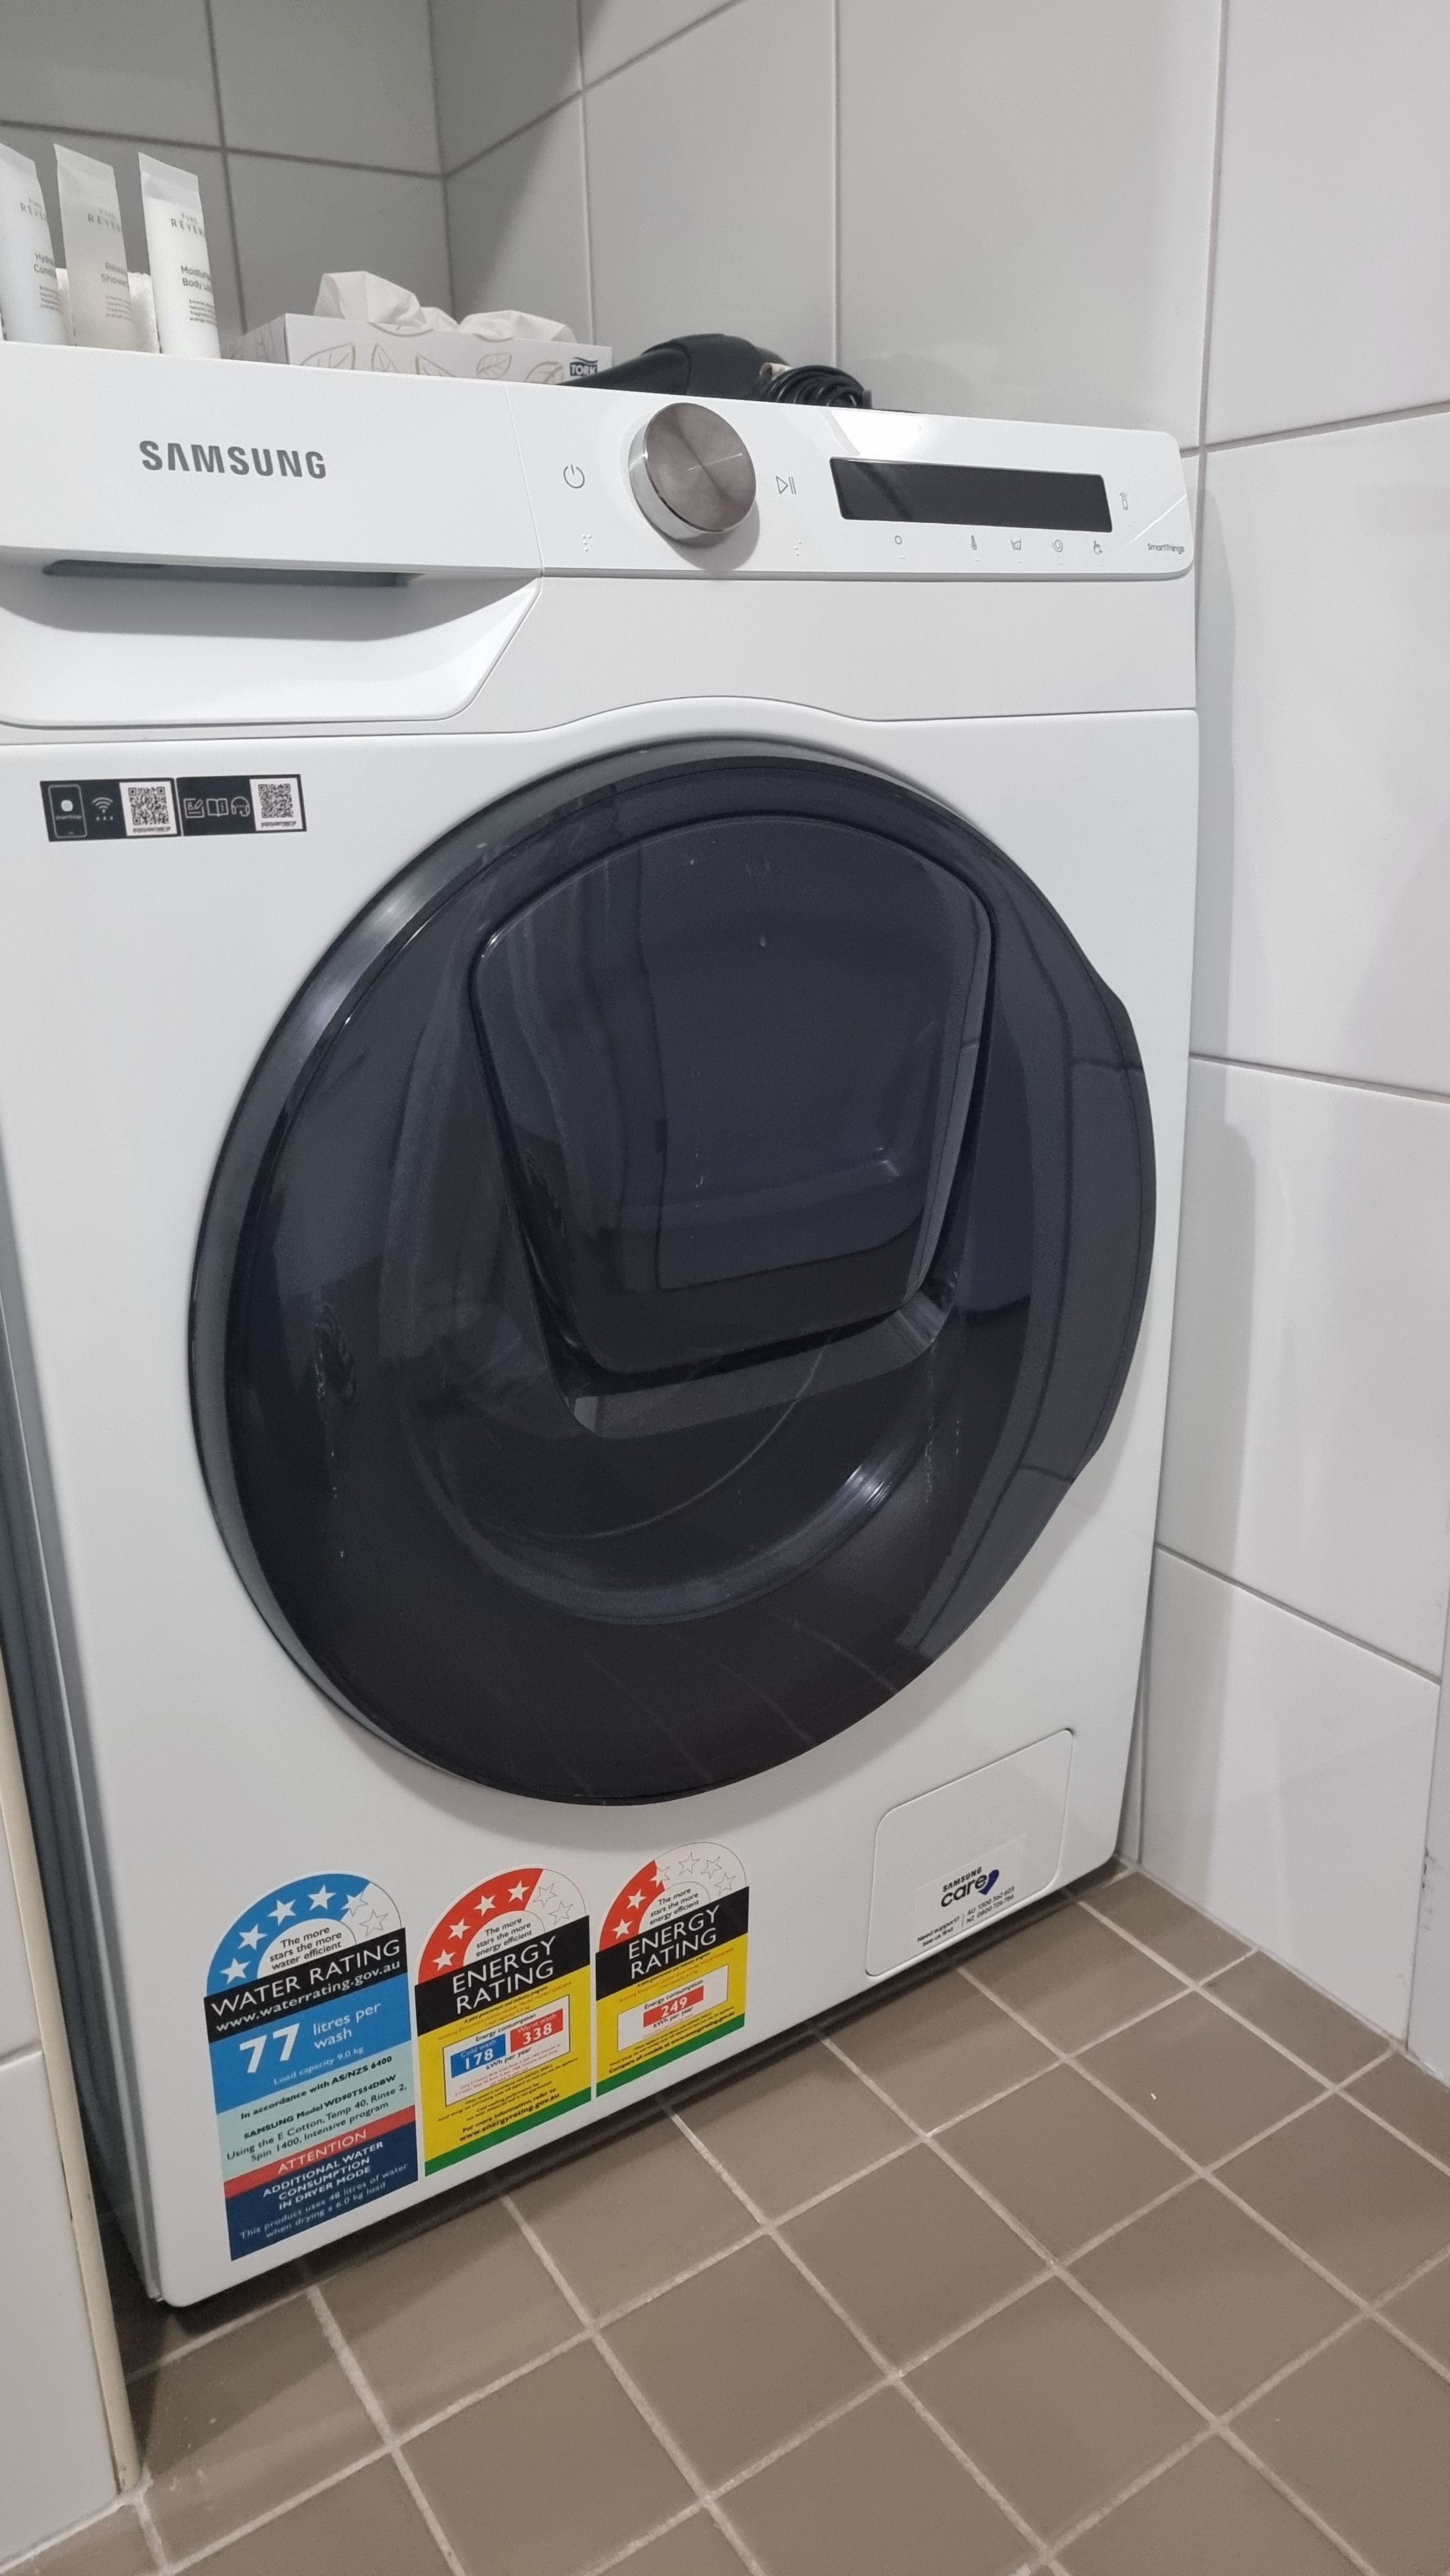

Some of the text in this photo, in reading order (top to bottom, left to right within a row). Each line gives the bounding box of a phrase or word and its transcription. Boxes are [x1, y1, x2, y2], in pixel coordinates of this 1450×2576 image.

[182, 278, 202, 290] Body
[571, 364, 596, 376] TORK
[139, 440, 326, 479] SAMSUNG
[941, 1874, 987, 1907] care
[943, 1866, 982, 1892] SAMSUNG
[649, 1899, 700, 1926] energy efficient
[650, 1892, 699, 1917] stars the more
[658, 1888, 691, 1906] The more
[280, 1927, 330, 1948] The more
[476, 1922, 531, 1948] stars the more
[484, 1918, 522, 1936] The more
[628, 1904, 720, 1960] ENERGY
[917, 1930, 934, 1942] Need
[270, 1932, 341, 1962] stars the more
[272, 1941, 341, 1970] water efficient
[476, 1930, 533, 1957] energy efficient
[631, 1927, 716, 1979] RATING
[211, 1939, 400, 2017] WATER RATING
[452, 1935, 556, 1994] ENERGY
[216, 1961, 400, 2032] www.waterrating.gov.au
[455, 1960, 554, 2015] RATING
[644, 1998, 665, 2010] Energy
[665, 1979, 704, 2000] consumption
[313, 2003, 381, 2035] litres per
[516, 2021, 538, 2033] Warm
[539, 2013, 557, 2023] wash
[661, 1996, 687, 2018] 249
[314, 2027, 351, 2049] wash
[476, 2029, 496, 2042] Energy
[498, 2013, 536, 2033] consumption
[522, 2023, 553, 2045] 338
[239, 2023, 300, 2074] 77
[460, 2039, 497, 2058] Cold wash
[465, 2048, 494, 2070] 178
[486, 2047, 532, 2071] kWh per year
[274, 2046, 364, 2085] Load capacity 9.0 kg
[254, 2090, 307, 2115] accordance
[309, 2081, 329, 2094] with
[331, 2065, 368, 2084] AS/NZS
[371, 2055, 392, 2069] 6400
[227, 2145, 256, 2160] Using
[258, 2138, 274, 2148] the
[278, 2131, 284, 2140] E
[287, 2116, 325, 2135] Cotton,
[326, 2106, 351, 2121] Temp
[355, 2100, 369, 2109] 40,
[371, 2090, 396, 2103] Rinse
[244, 2115, 294, 2139] SAMSUNG
[296, 2104, 323, 2119] Model
[459, 2093, 560, 2141] www.energyrating.gov.au
[463, 2125, 473, 2133] For
[475, 2116, 493, 2128] more
[494, 2099, 533, 2118] information,
[533, 2092, 549, 2101] refer
[251, 2102, 388, 2161] Spin 1400, Intensive program
[277, 2129, 367, 2174] ATTENTION
[263, 2141, 384, 2198] ADDITIONAL WATER
[278, 2157, 370, 2200] CONSUMPTION
[241, 2163, 408, 2239] This product uses 48 litres of water
[279, 2165, 371, 2210] IN DRYER MODE
[266, 2223, 292, 2238] when
[295, 2209, 325, 2224] drying
[353, 2192, 364, 2200] kg
[366, 2181, 386, 2195] load
